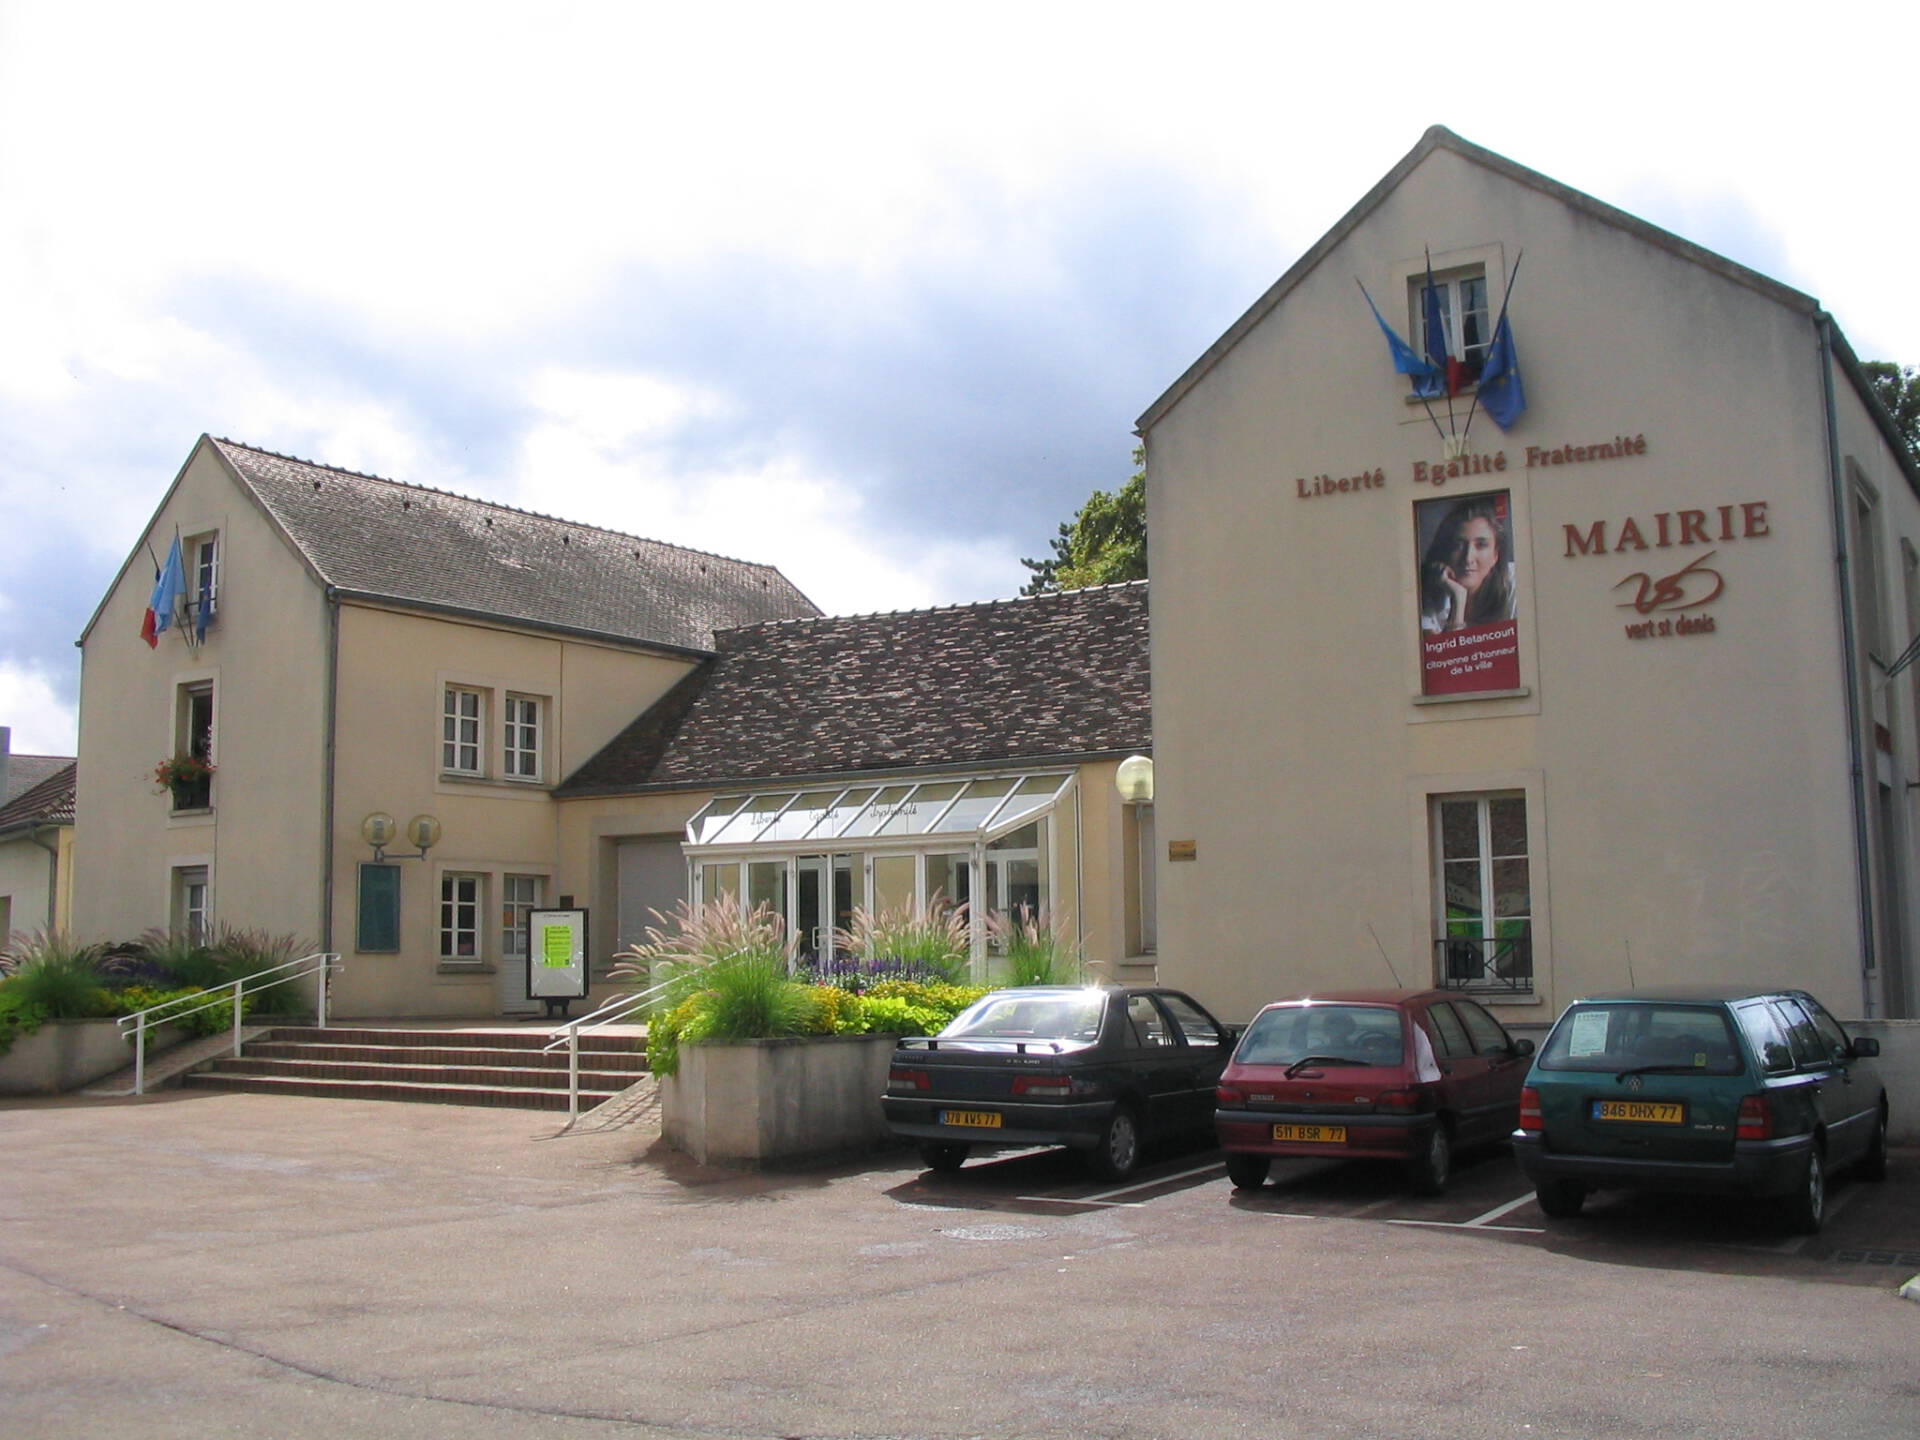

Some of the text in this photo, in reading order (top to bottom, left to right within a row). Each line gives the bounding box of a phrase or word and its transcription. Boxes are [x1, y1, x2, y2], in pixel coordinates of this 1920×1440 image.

[1296, 433, 1647, 499] Liberté Egalité Fraternité
[1562, 501, 1769, 557] MAIRIE
[1625, 614, 1716, 639] vert st denis
[1426, 627, 1515, 652] Ingrid Betancourt
[1426, 646, 1516, 670] citoyenne d'honneur
[1450, 661, 1493, 675] de la ville
[985, 1113, 995, 1126] 77
[1601, 1103, 1677, 1119] 846 DHX 77
[1276, 1126, 1343, 1140] 511 BSR 77
